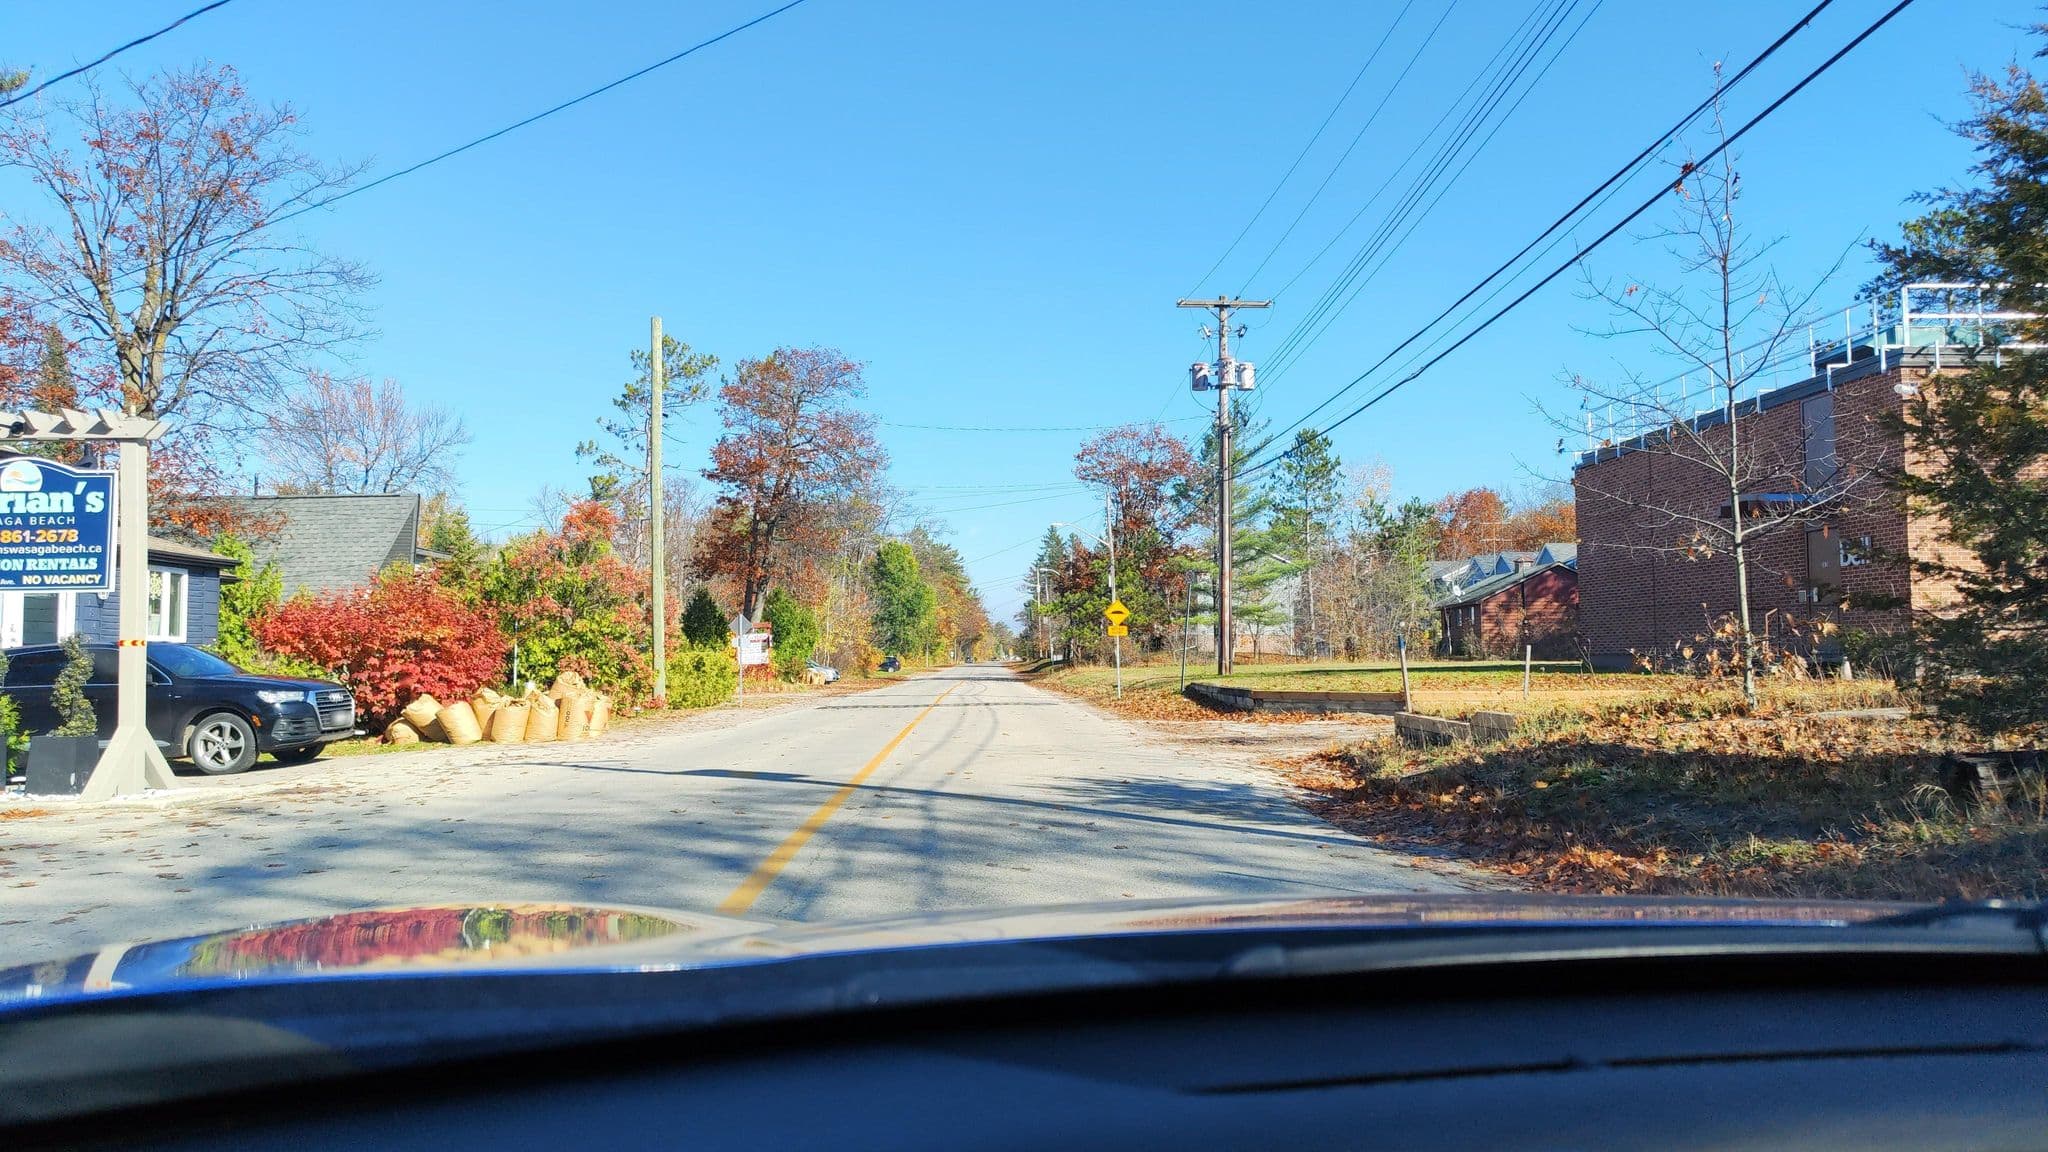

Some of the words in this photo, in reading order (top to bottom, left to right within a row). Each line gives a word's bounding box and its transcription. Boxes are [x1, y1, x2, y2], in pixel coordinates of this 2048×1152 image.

[29, 516, 76, 526] BEACH
[0, 529, 79, 544] 861-2678
[25, 557, 98, 571] RENTALS
[22, 575, 42, 585] NO
[43, 574, 102, 585] VACANCY
